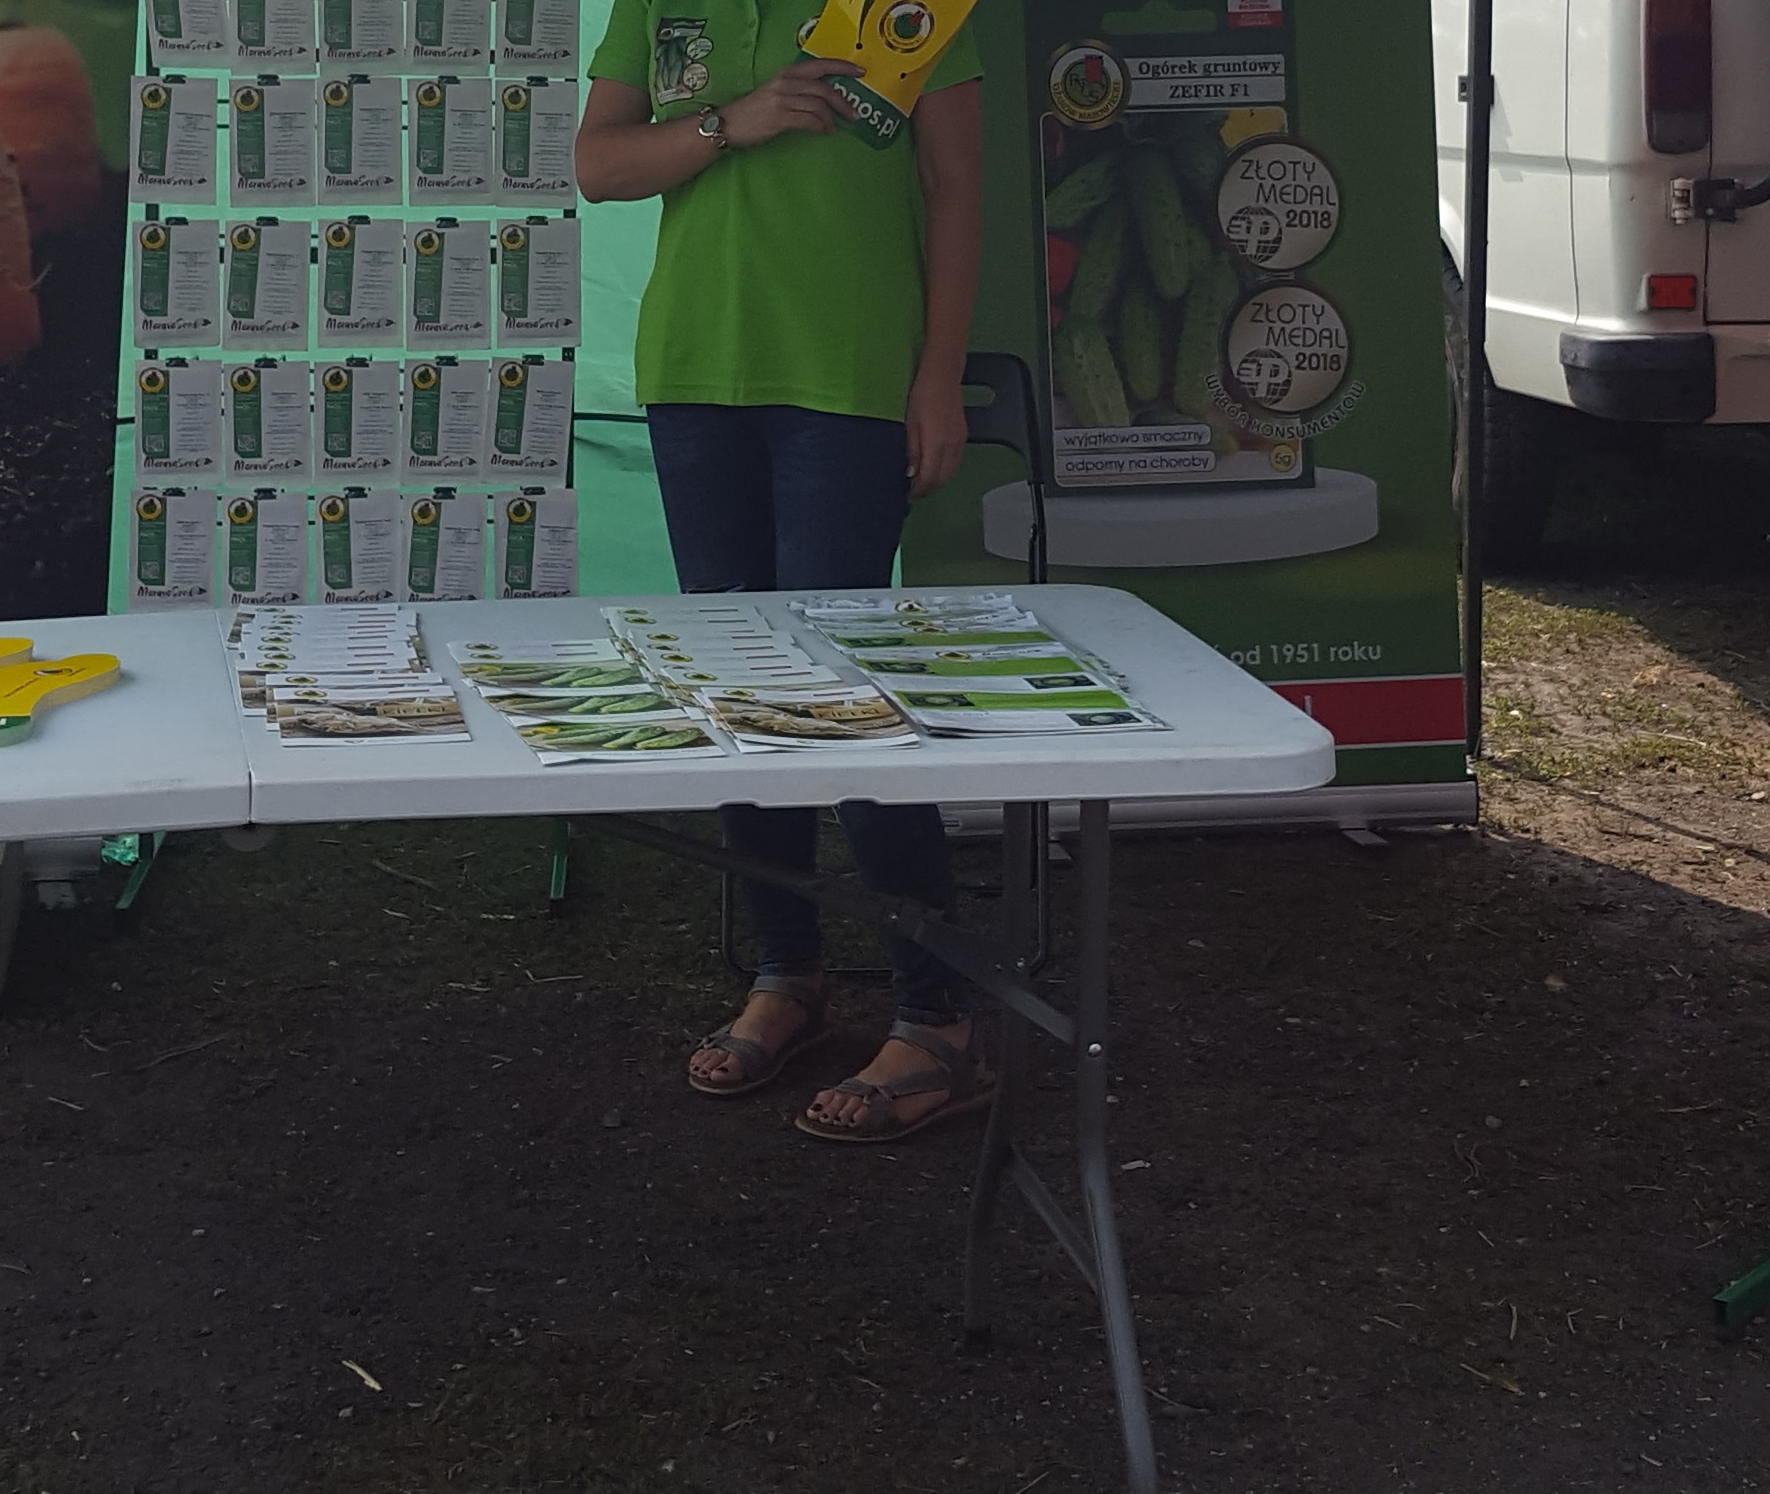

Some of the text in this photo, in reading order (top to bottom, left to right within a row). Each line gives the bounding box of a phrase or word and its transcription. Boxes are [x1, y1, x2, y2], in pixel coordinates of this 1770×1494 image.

[1138, 59, 1281, 78] Ogórek gruntowy
[1169, 84, 1225, 99] ZEFIR
[1240, 159, 1316, 182] ZŁOTY
[1256, 183, 1337, 206] MEDAL
[1285, 209, 1332, 229] 2018
[1250, 302, 1325, 325] ZŁOTY
[1266, 326, 1347, 349] MEDAL
[1295, 352, 1341, 372] 2018
[1270, 642, 1319, 665] 1951
[1329, 640, 1382, 662] roku
